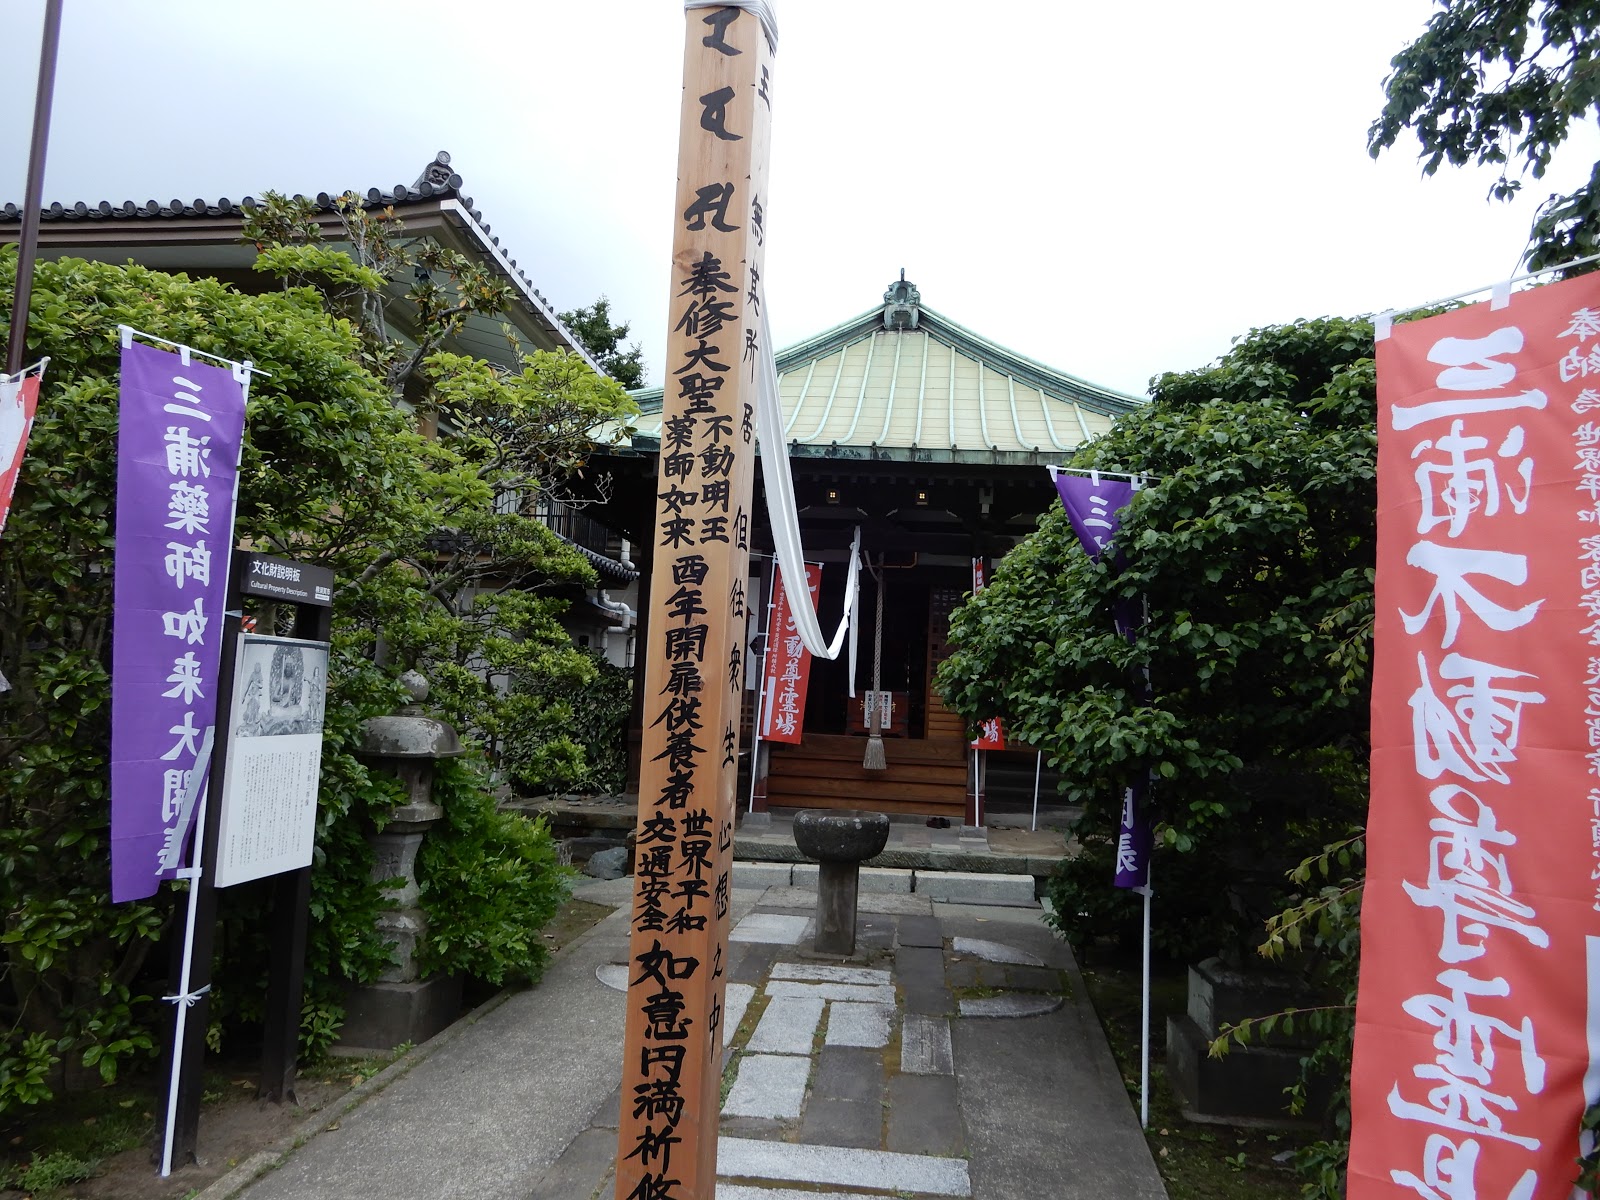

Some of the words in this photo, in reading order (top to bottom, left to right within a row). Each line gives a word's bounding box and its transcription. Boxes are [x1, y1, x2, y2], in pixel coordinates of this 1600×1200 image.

[673, 251, 739, 414] 奉修大聖
[657, 414, 699, 549] 薬師如来
[697, 415, 735, 544] 不動明王
[250, 580, 268, 590] Cultural
[268, 584, 286, 594] Property
[287, 587, 308, 597] Description
[252, 560, 301, 582] 文化財説明板
[632, 811, 677, 933] 交通安全
[665, 808, 713, 934] 世界平和
